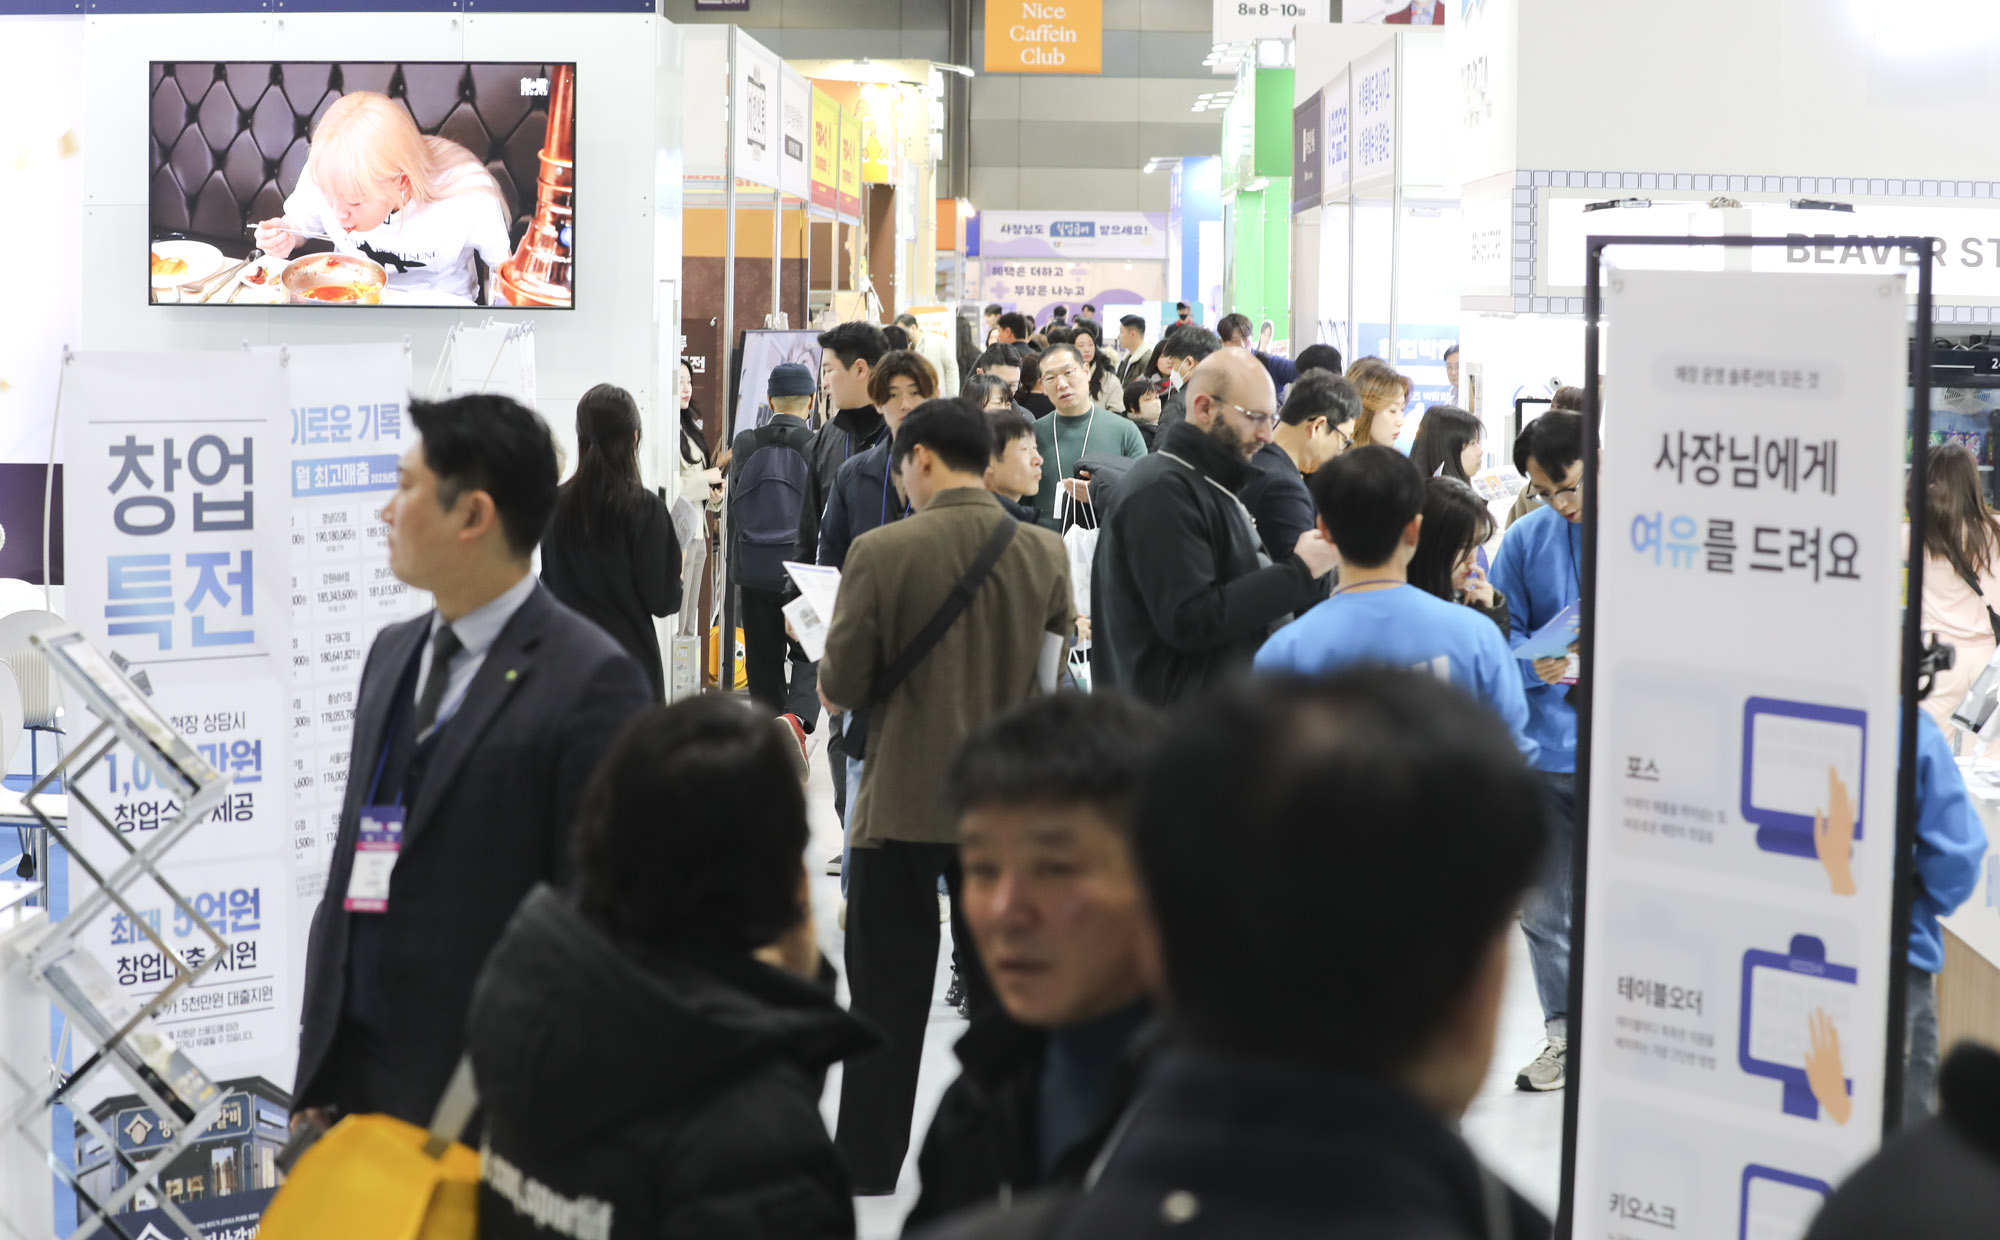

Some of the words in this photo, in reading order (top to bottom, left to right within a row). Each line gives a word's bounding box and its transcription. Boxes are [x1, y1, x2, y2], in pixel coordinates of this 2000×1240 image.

[1022, 2, 1067, 20] Nice
[1009, 25, 1077, 43] Caffein
[1020, 47, 1066, 65] Club
[1000, 224, 1044, 235] 사장님도
[1099, 225, 1148, 236] 받으세요!
[1786, 233, 1948, 266] BEAVER
[992, 266, 1026, 277] 혜택은
[1031, 266, 1064, 277] 더하고
[1052, 285, 1085, 296] 나누고
[358, 403, 401, 441] 기록
[295, 464, 310, 491] 월
[314, 461, 370, 488] 최고매출
[1655, 429, 1838, 496] 사장님에게
[107, 434, 254, 536] 창업
[1631, 511, 1737, 575] 여유를
[1749, 526, 1861, 583] 드려요
[104, 549, 255, 651] 특전
[203, 711, 246, 733] 상담시
[1626, 756, 1661, 782] 포스
[111, 908, 161, 945] 최대
[173, 887, 260, 938] 5억원
[181, 992, 224, 1012] 5천만원
[228, 985, 273, 1006] 대출지원
[1616, 975, 1704, 1016] 테이블오더
[1609, 1192, 1677, 1230] 키오스크
